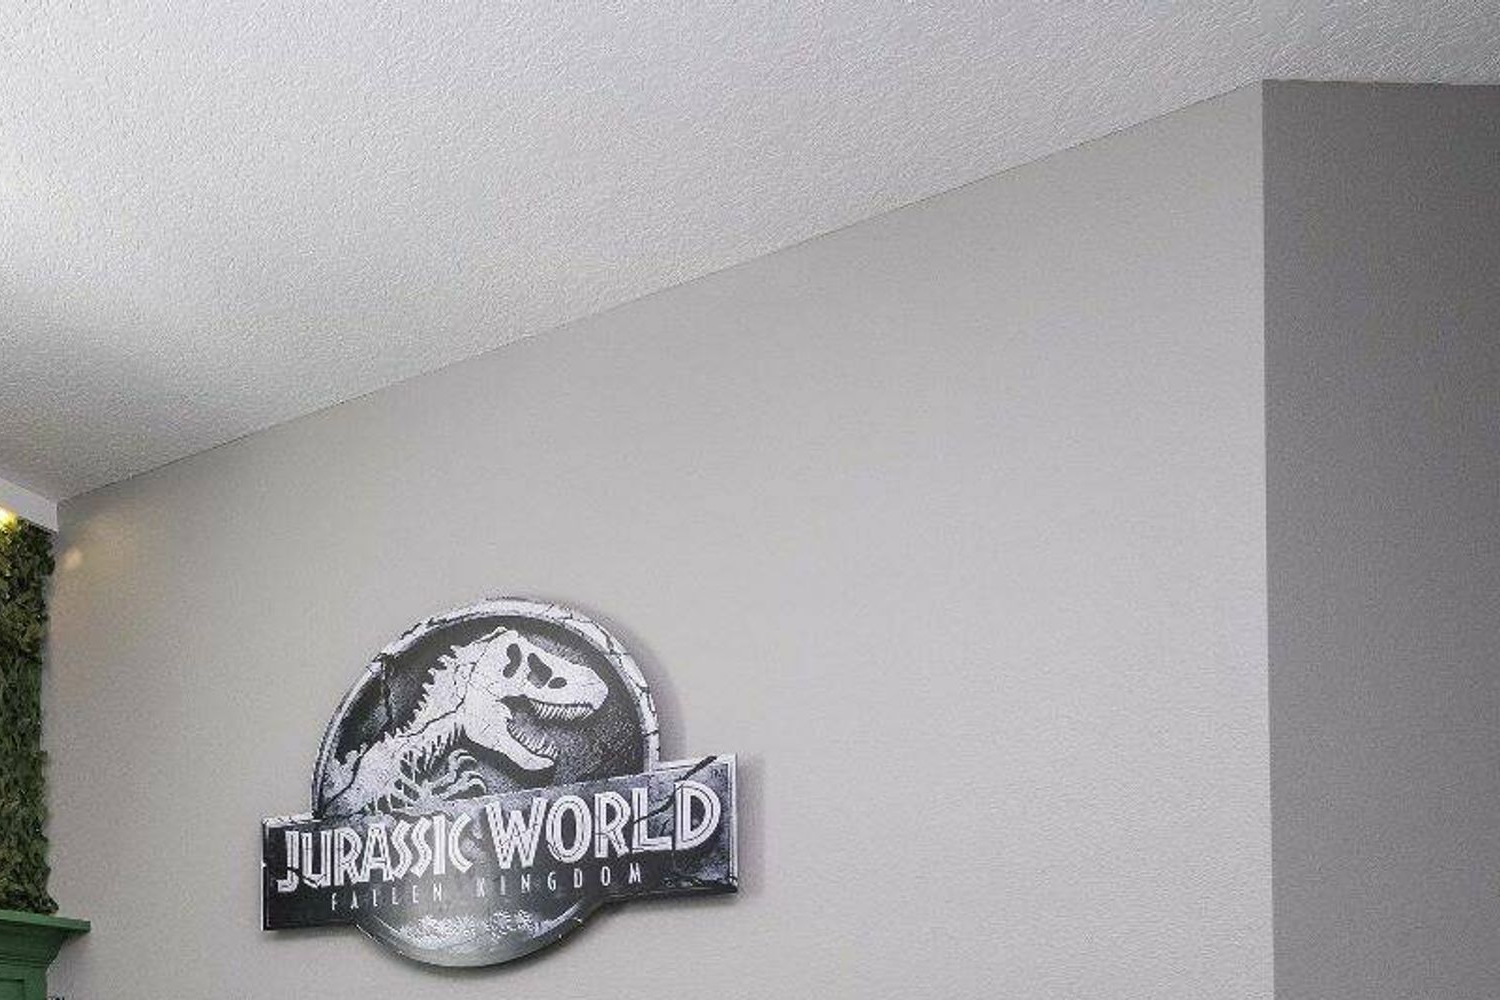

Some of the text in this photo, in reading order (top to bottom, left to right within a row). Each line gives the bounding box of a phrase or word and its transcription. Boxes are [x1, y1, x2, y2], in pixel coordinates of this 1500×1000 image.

[277, 781, 722, 893] JURASSIC WORLD
[331, 862, 642, 911] FALLEN KINGDOM
